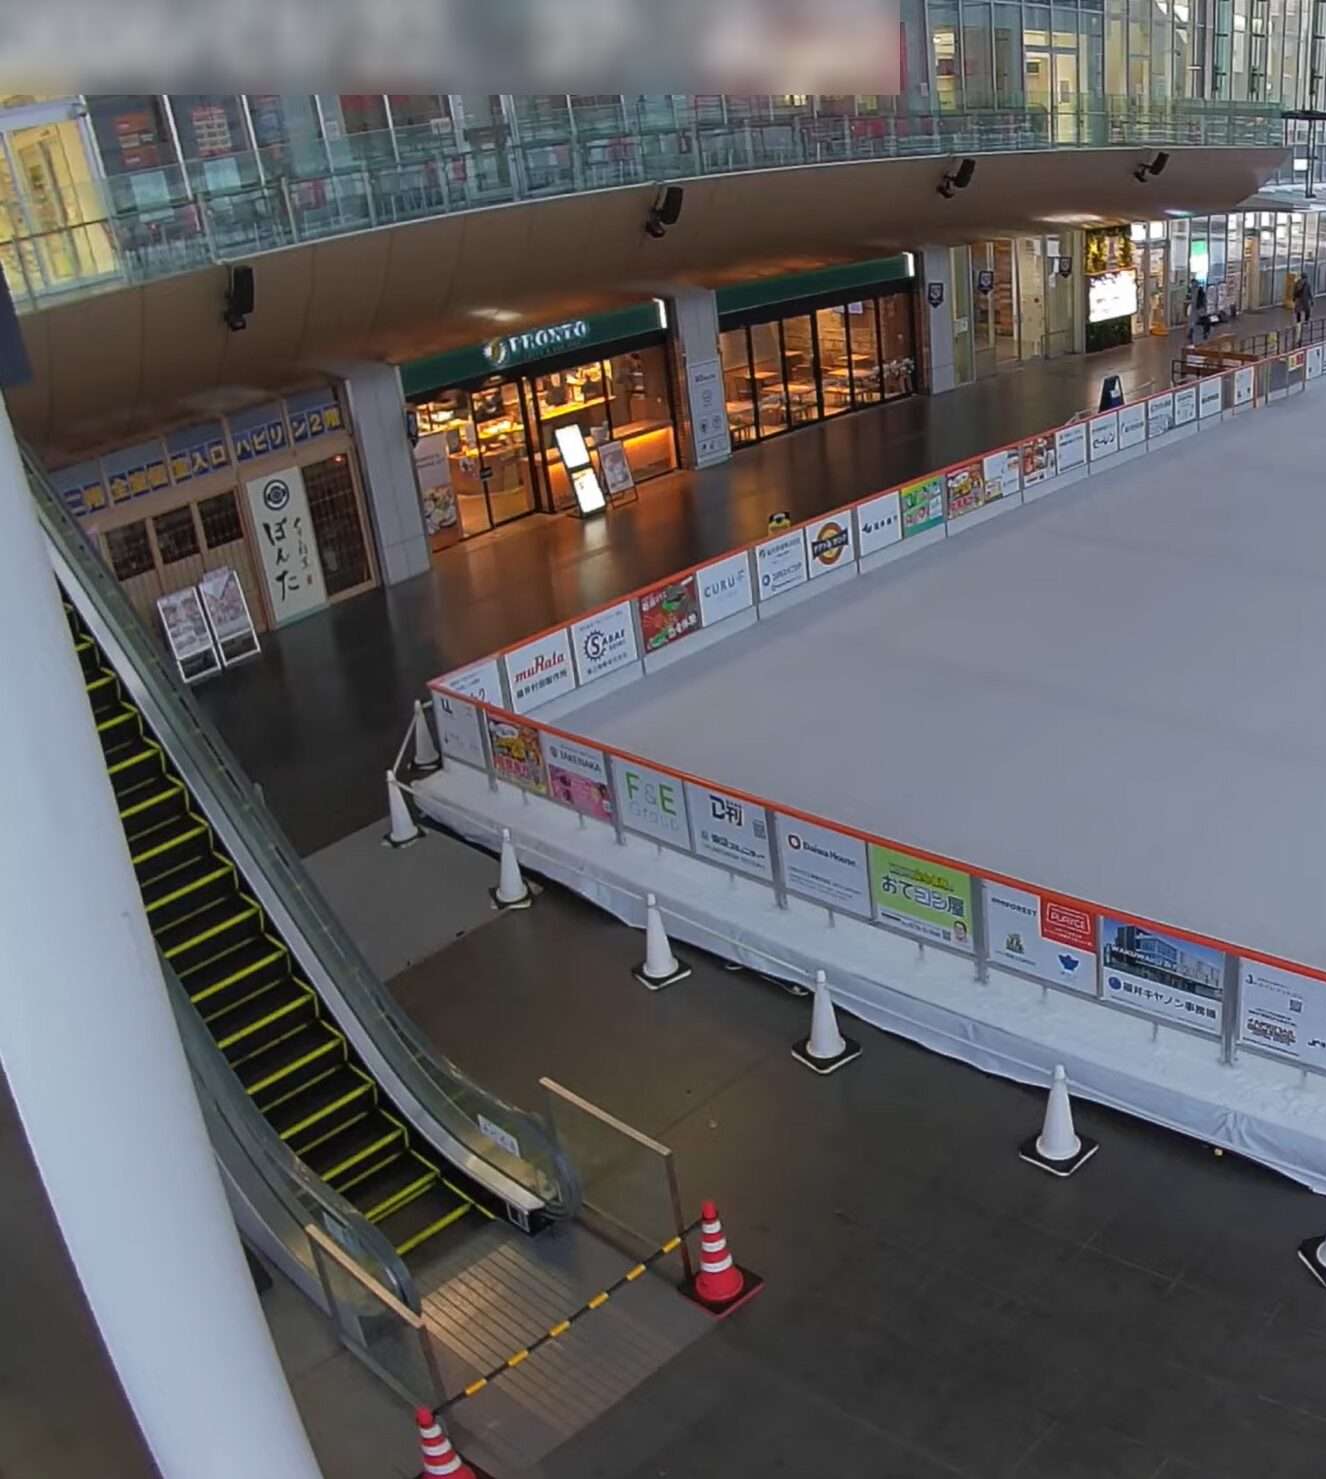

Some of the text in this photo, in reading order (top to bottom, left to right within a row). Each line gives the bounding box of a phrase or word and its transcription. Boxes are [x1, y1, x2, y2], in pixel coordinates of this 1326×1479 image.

[508, 320, 588, 351] PRONTO
[262, 518, 300, 601] ぼんた
[514, 650, 565, 683] muRata
